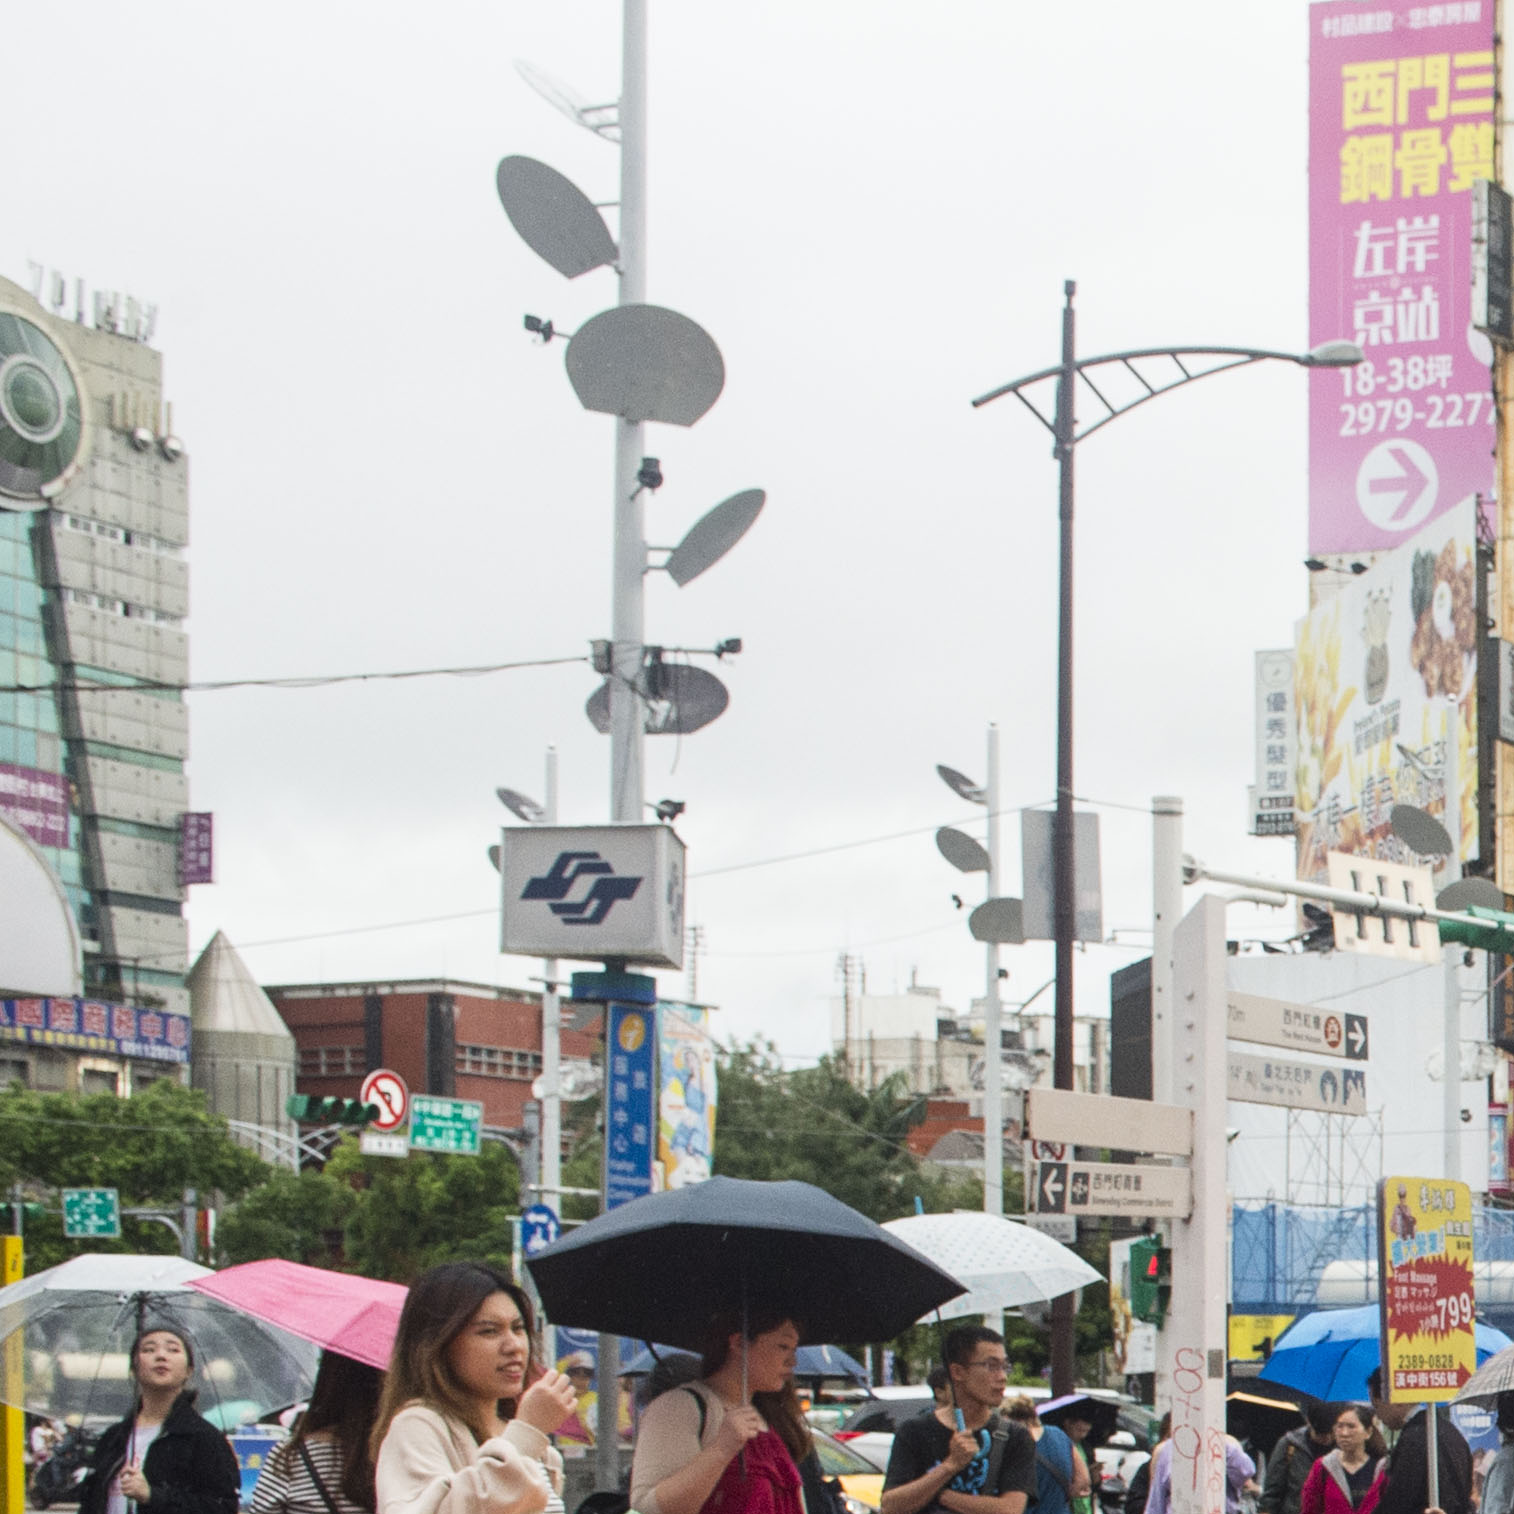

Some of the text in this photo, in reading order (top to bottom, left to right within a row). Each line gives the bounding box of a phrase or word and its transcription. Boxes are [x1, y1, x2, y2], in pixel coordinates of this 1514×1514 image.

[1354, 214, 1440, 278] 左岸
[1437, 1292, 1472, 1331] 799
[1398, 1354, 1454, 1369] 2389-0828
